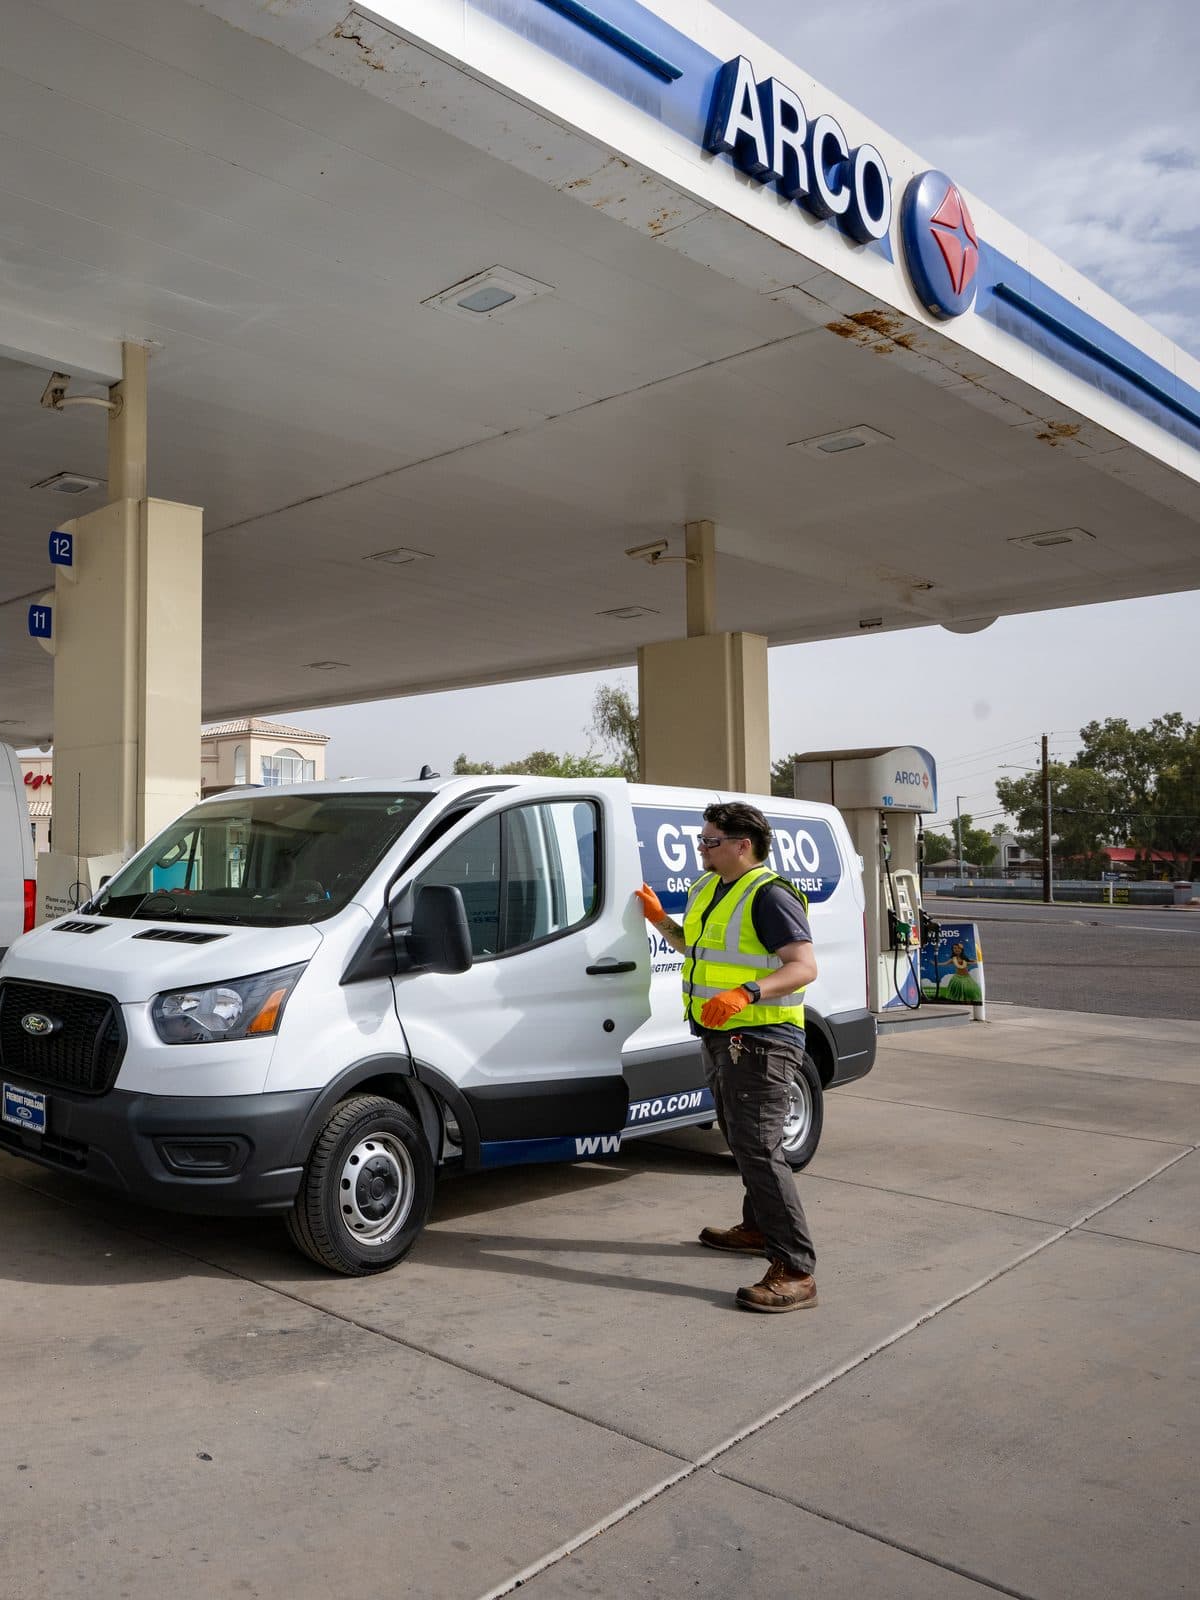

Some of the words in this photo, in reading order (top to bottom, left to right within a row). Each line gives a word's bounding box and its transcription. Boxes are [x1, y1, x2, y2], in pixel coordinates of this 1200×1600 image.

[716, 55, 891, 240] ARCO
[53, 538, 70, 557] 12
[33, 611, 46, 630] 11
[895, 770, 921, 786] ARCO
[882, 795, 893, 806] 10
[667, 877, 692, 893] GAS
